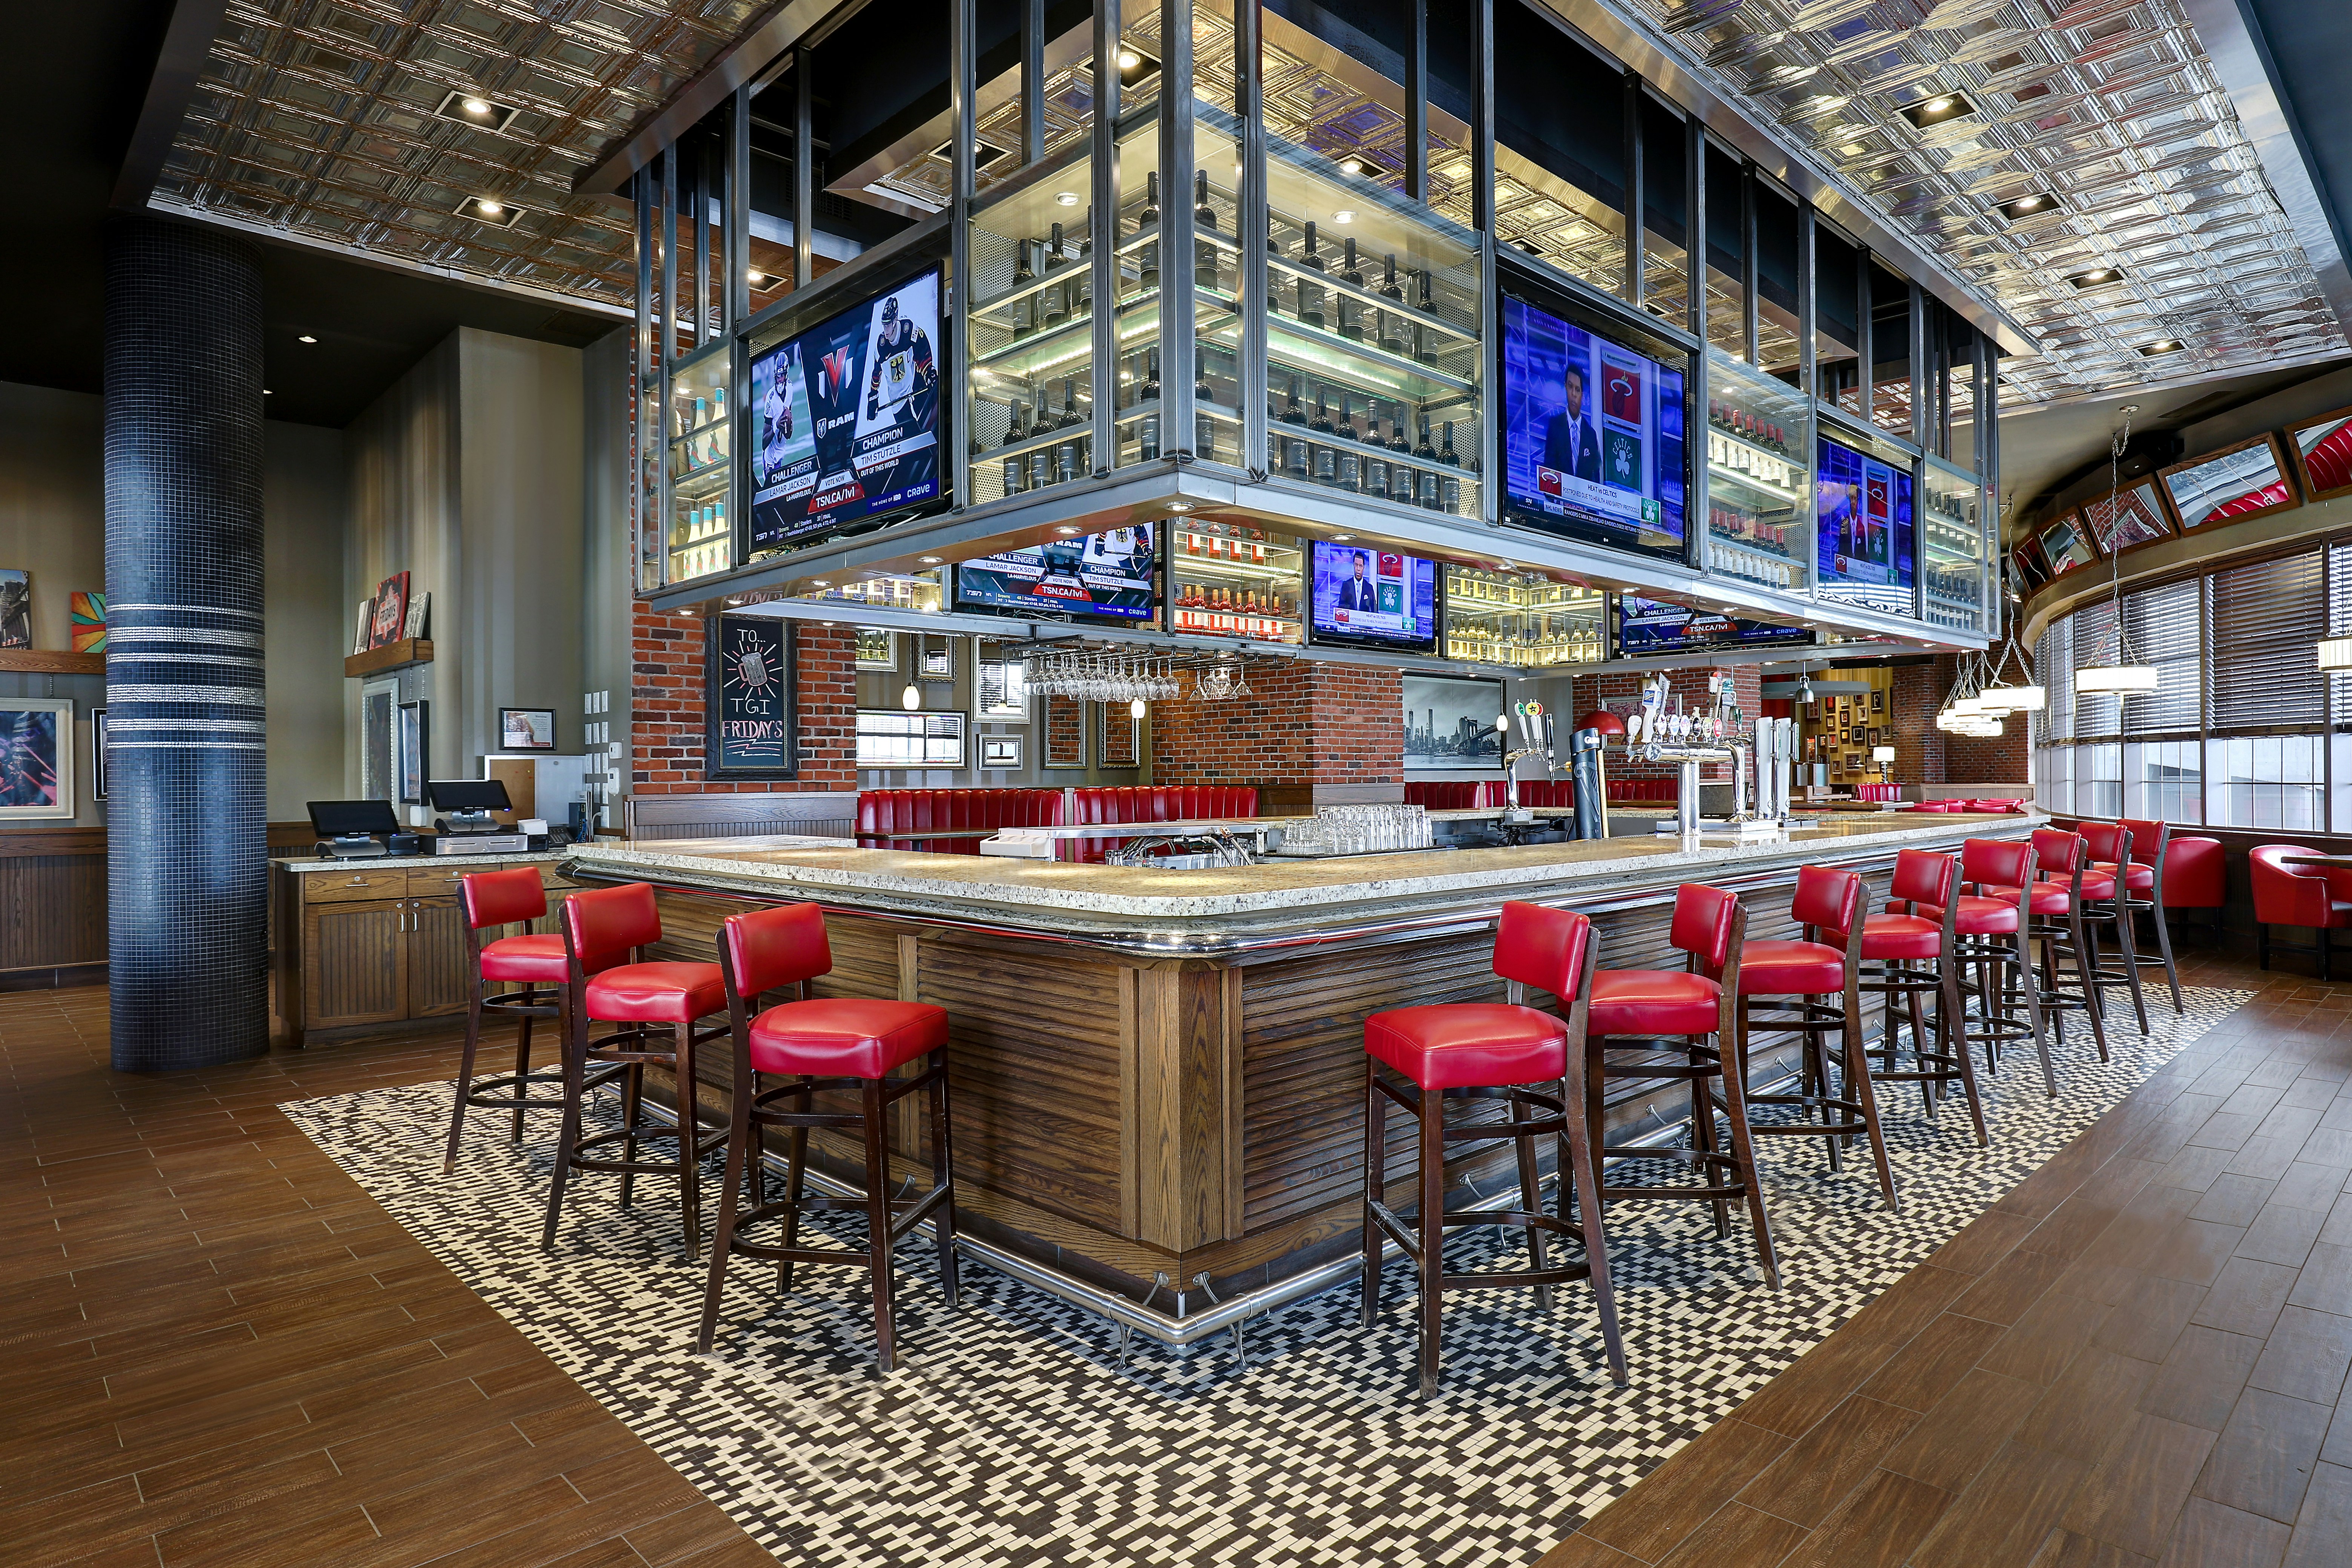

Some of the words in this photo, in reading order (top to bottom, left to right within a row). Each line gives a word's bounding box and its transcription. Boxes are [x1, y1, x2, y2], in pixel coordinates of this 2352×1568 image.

[828, 411, 854, 429] RAM
[863, 427, 903, 451] CHAMPION
[861, 455, 872, 465] TIM
[873, 444, 901, 461] STÜTZLE
[1612, 438, 1633, 459] CELTICS
[771, 461, 812, 484] CHALLENGER
[875, 464, 884, 473] THIS
[884, 458, 899, 470] WORLD
[769, 485, 787, 497] LAMAR
[788, 476, 811, 490] JACKSON
[825, 478, 835, 487] VOTE
[835, 475, 845, 484] NOW
[786, 489, 811, 502] LA-MARVELOUS
[1563, 487, 1581, 497] POSTPONED
[1593, 496, 1605, 504] HEALTH
[1612, 501, 1623, 509] SAFETY
[1623, 504, 1640, 514] PROTOCOLS
[1603, 489, 1617, 498] CELTICS
[1056, 540, 1082, 549] RAM
[986, 562, 1008, 570] LAMAR
[1009, 565, 1036, 573] JACKSON
[1090, 566, 1126, 576] CHAMPION
[1007, 573, 1037, 581] LA-MARVELOUS
[1100, 576, 1124, 585] STÜTZLE
[1644, 607, 1685, 616] CHALLENGER
[730, 698, 771, 714] TGI
[1874, 694, 1880, 707] F
[722, 720, 783, 739] FRIDAY'S
